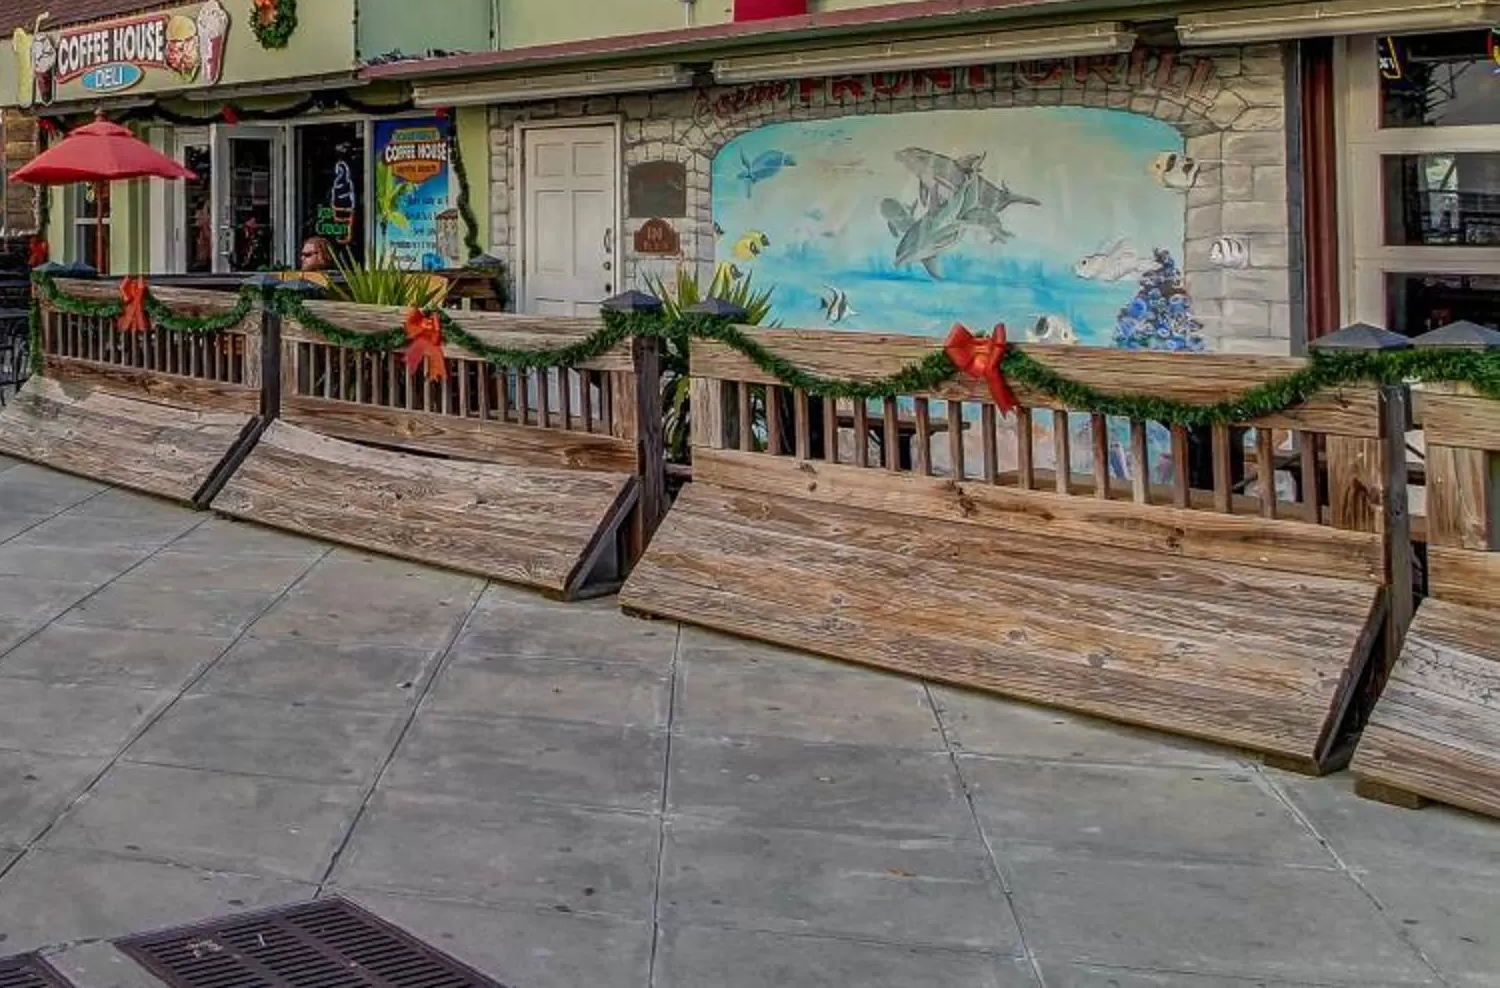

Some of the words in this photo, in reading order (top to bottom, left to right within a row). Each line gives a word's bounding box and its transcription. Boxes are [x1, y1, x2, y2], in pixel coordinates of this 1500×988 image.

[58, 30, 110, 75] COFFEE
[113, 20, 165, 62] HOUSE
[95, 67, 124, 86] DELI
[385, 144, 416, 163] COFFEE
[417, 142, 447, 161] HOUSE
